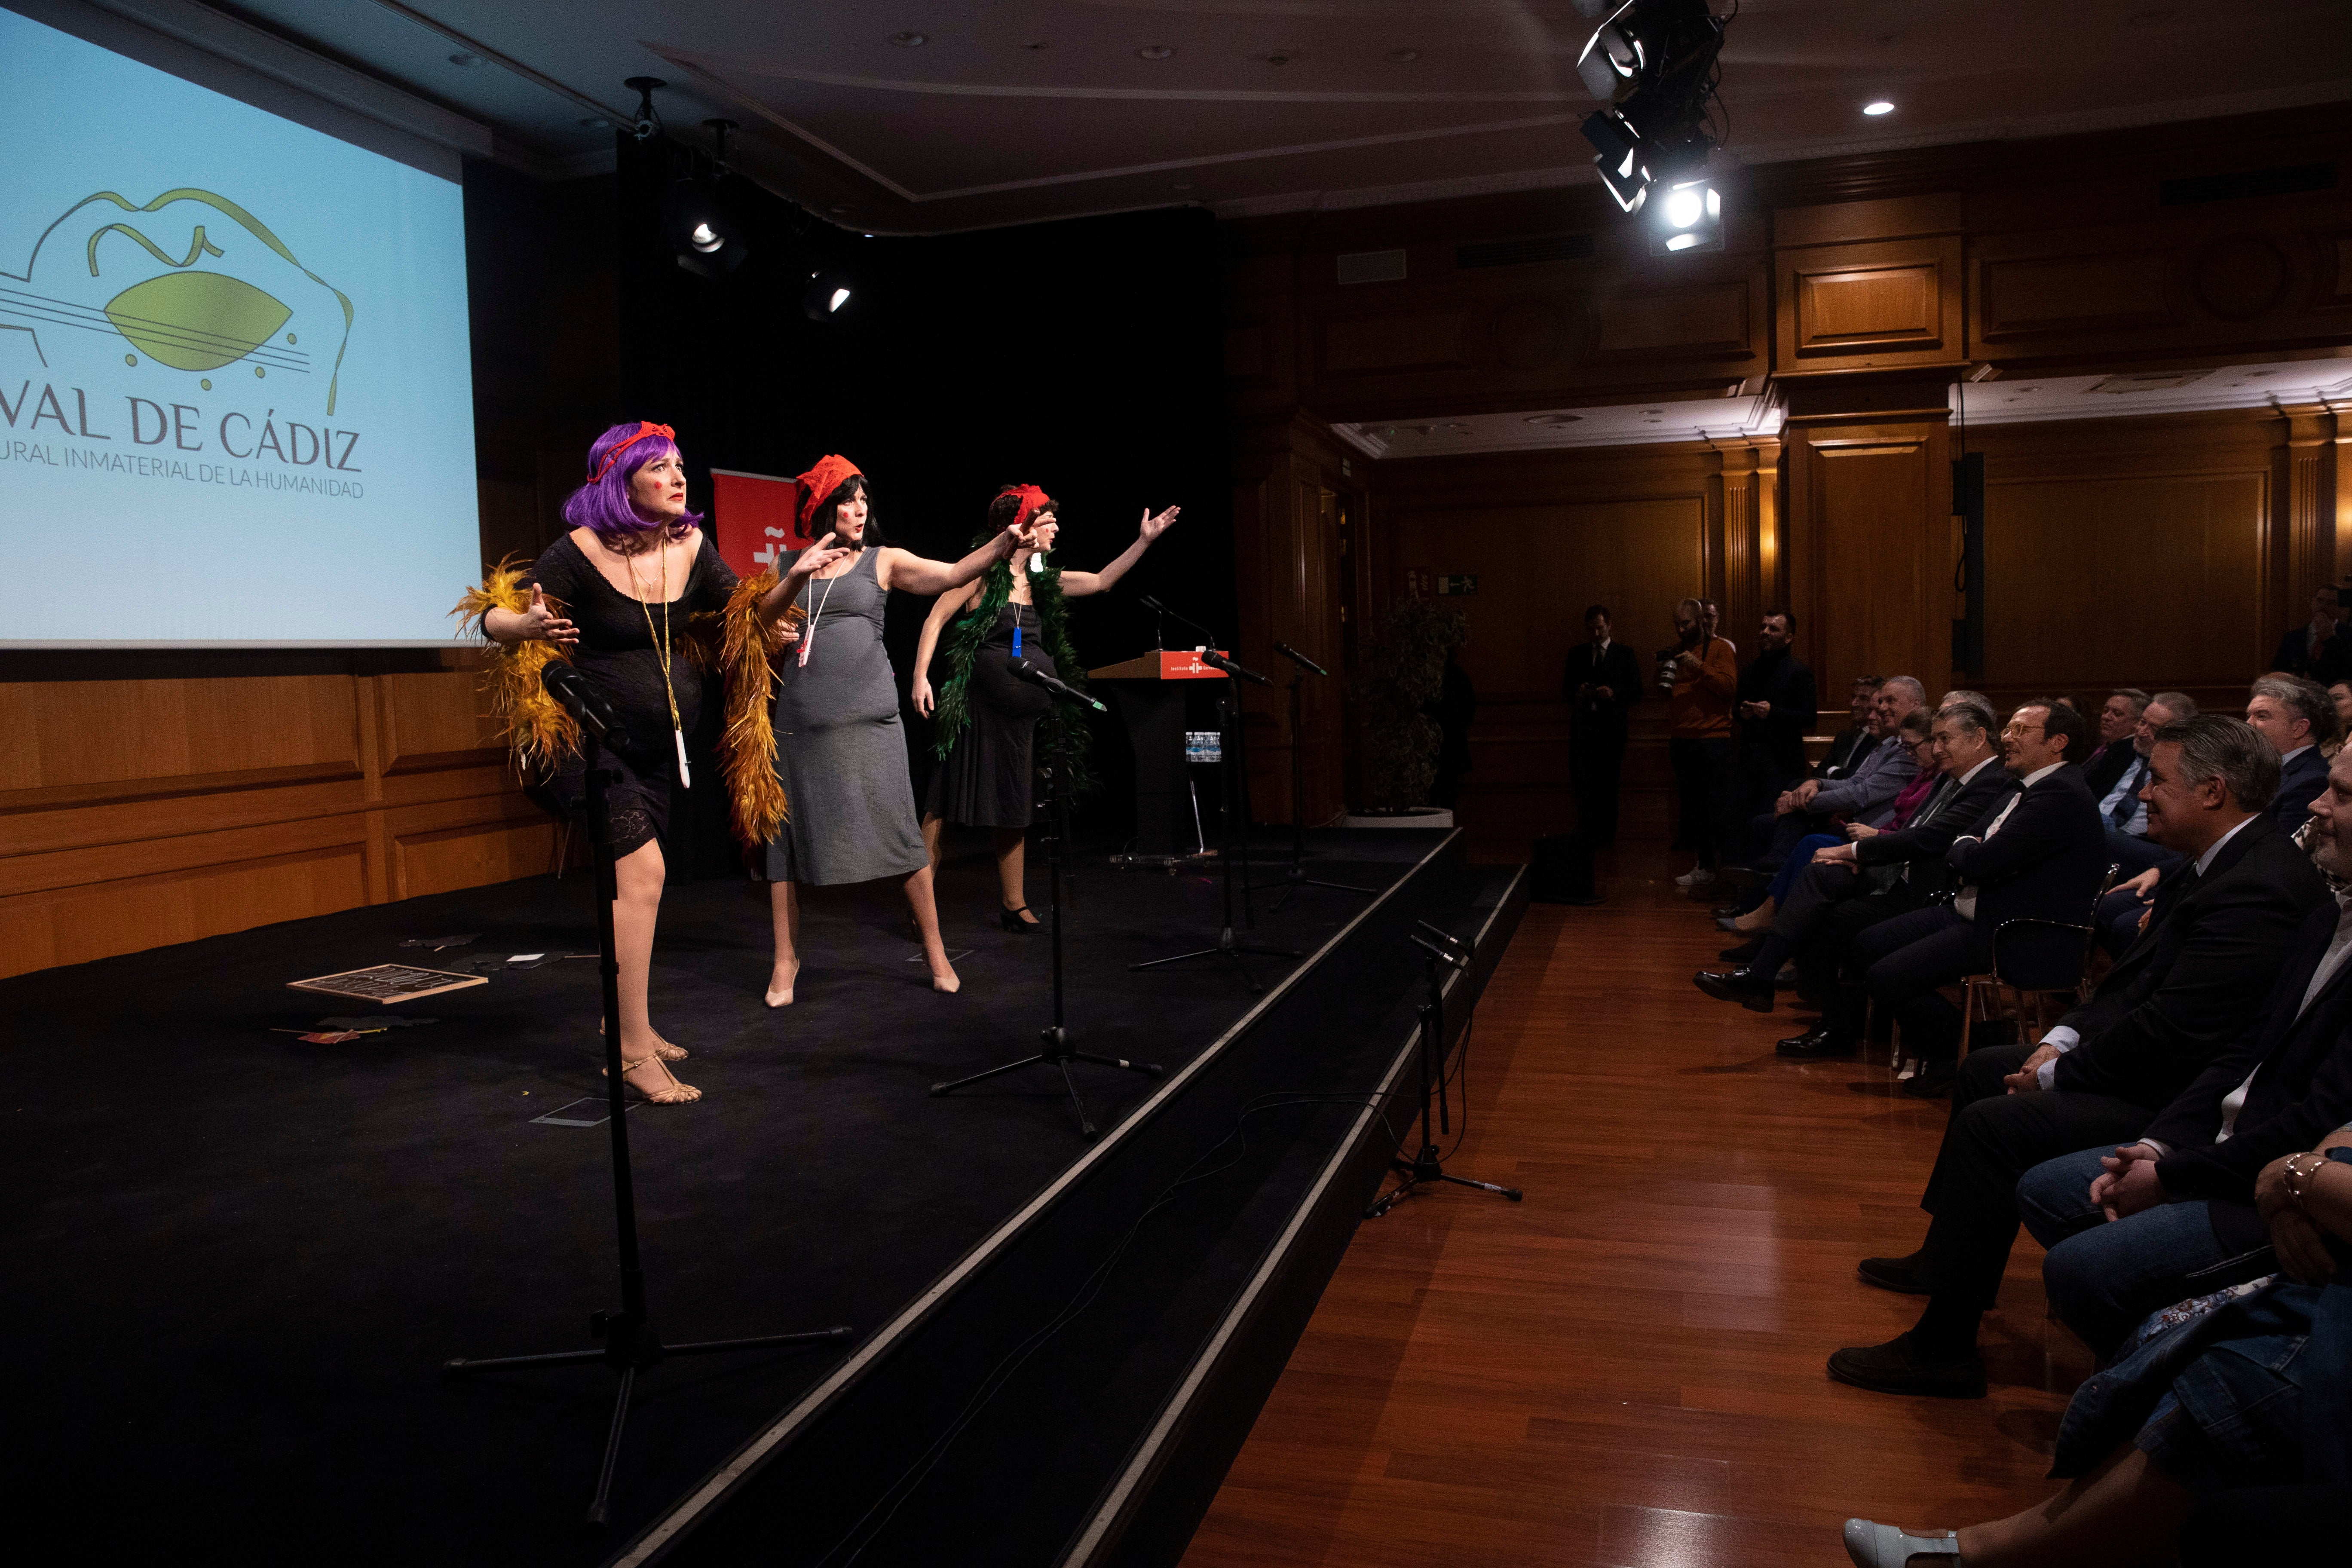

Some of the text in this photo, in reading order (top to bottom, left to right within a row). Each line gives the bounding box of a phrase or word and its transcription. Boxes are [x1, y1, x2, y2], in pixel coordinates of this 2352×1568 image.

[0, 380, 362, 473] VAL DE CÁDIZ
[65, 448, 195, 481] INMATERIAL
[199, 464, 225, 484] DE
[230, 468, 252, 487] LA
[256, 471, 364, 499] HUMANIDAD
